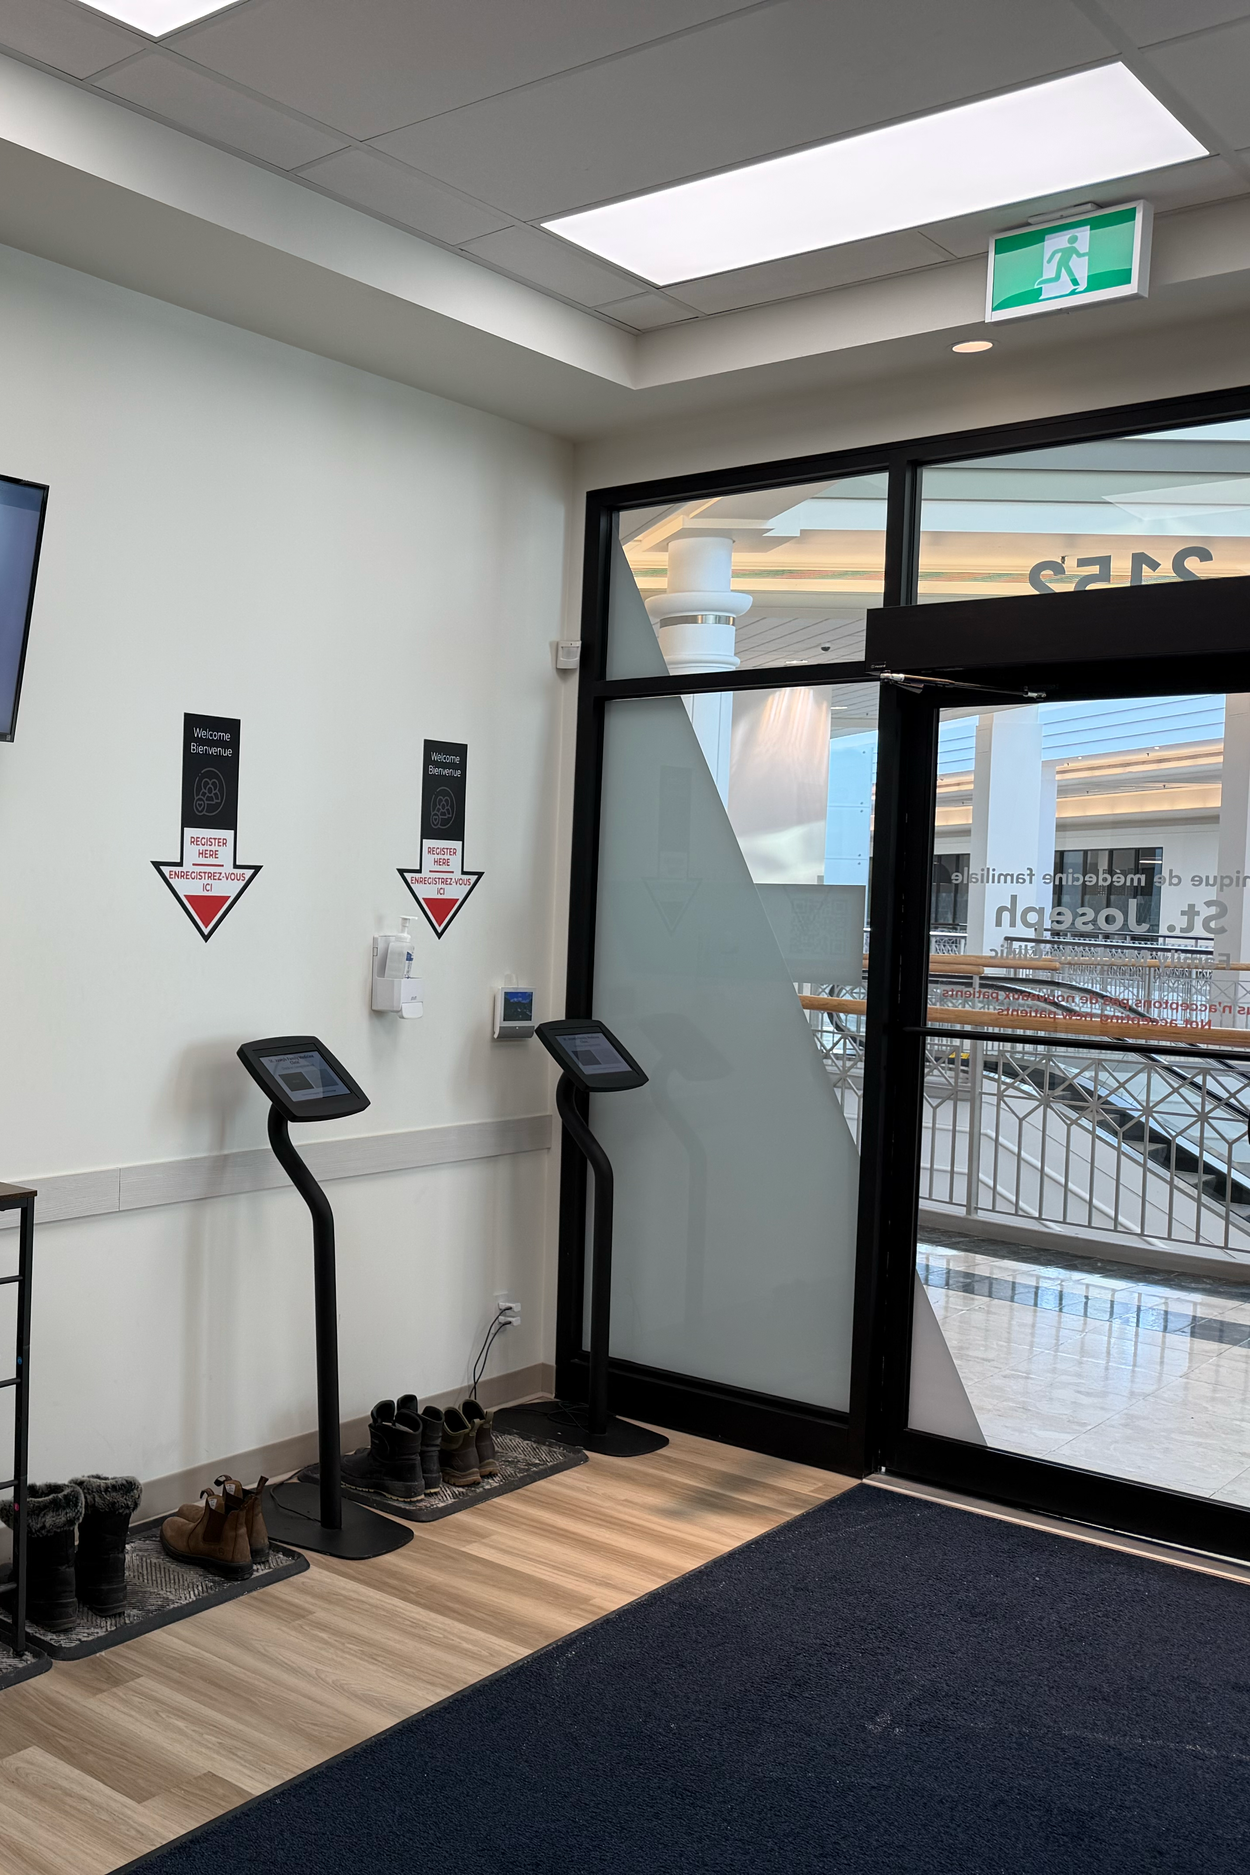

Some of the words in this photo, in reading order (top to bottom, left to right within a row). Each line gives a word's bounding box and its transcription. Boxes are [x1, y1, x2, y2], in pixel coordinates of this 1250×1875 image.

[193, 727, 230, 741] Welcome
[190, 742, 232, 757] Bienvenue
[431, 751, 460, 764] Welcome
[428, 764, 461, 777] Bienvenue
[190, 836, 228, 847] REGISTER
[198, 849, 219, 859] HERE
[427, 846, 457, 856] REGISTER
[433, 858, 450, 866] HERE
[169, 870, 246, 882] ENREGISTREZ-VOUS
[410, 876, 472, 886] ENREGISTREZ-VOUS
[202, 883, 213, 892] ICI
